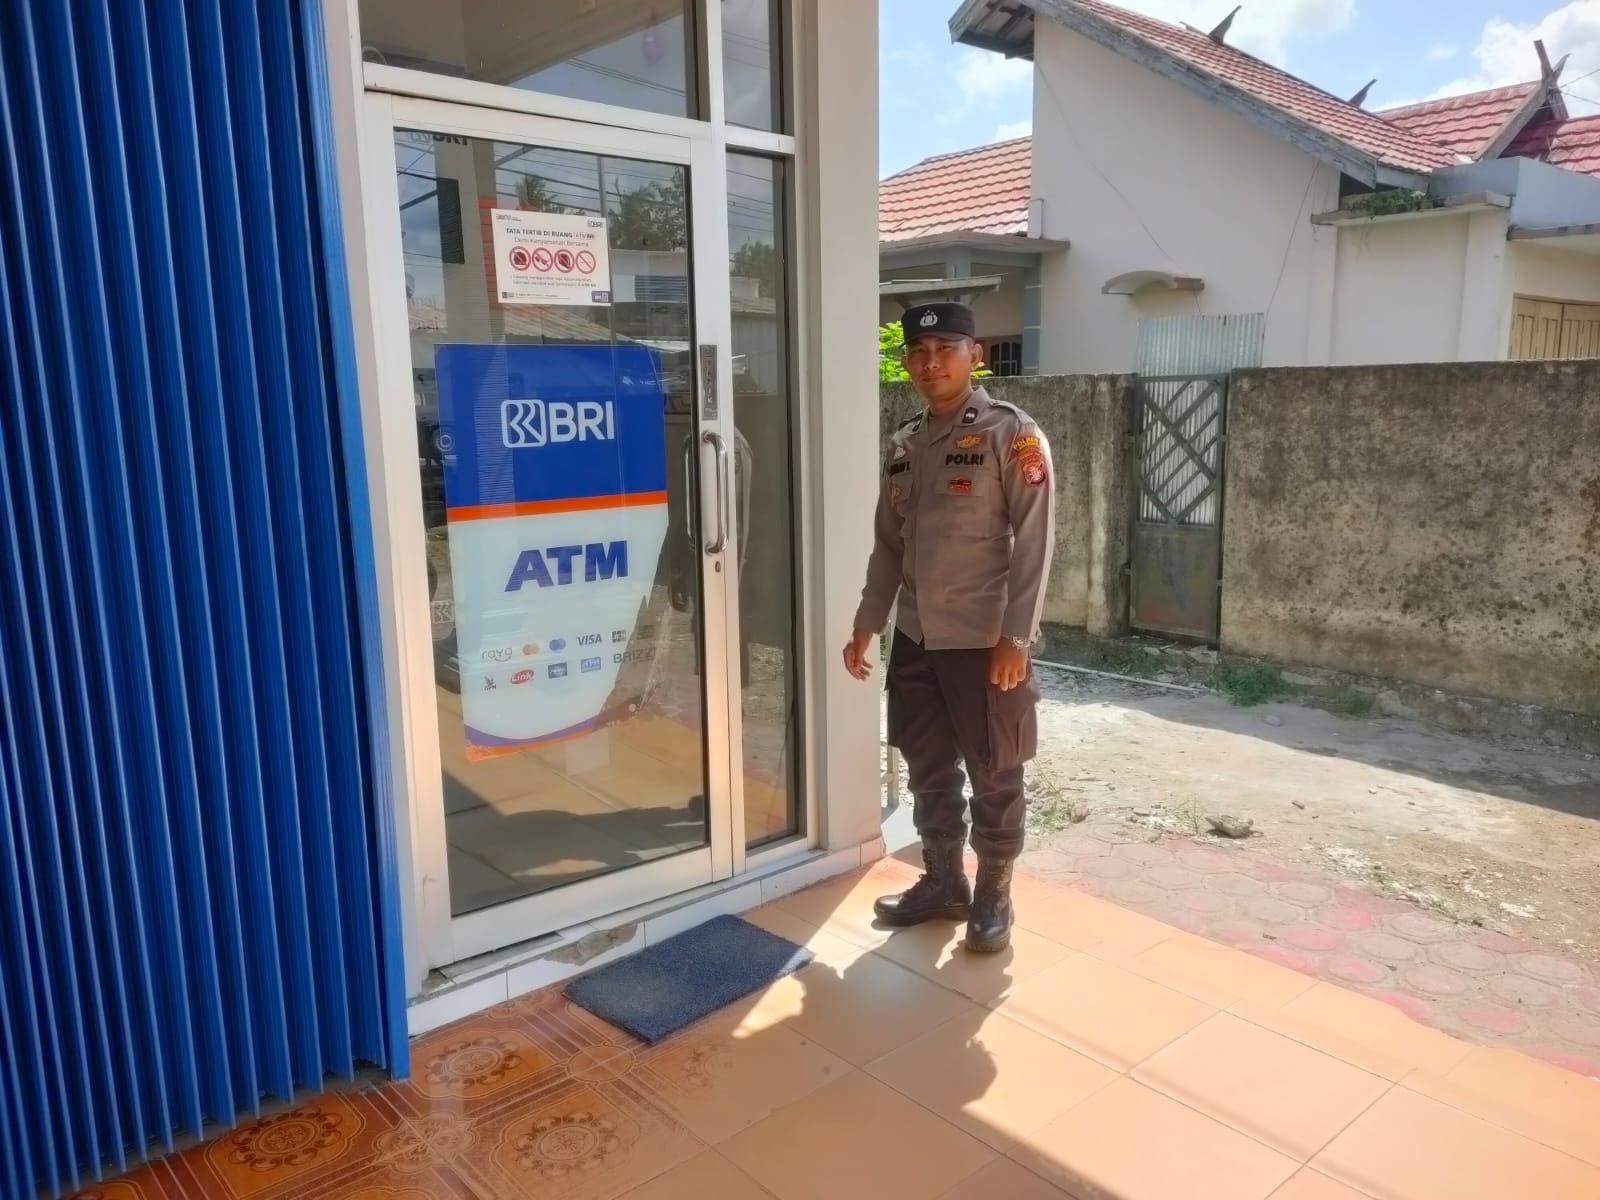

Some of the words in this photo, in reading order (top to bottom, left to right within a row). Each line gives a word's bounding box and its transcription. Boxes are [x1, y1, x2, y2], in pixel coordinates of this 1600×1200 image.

[549, 400, 615, 443] BRI
[945, 453, 985, 466] POLRI
[504, 540, 629, 593] ATM
[577, 633, 603, 646] VISA
